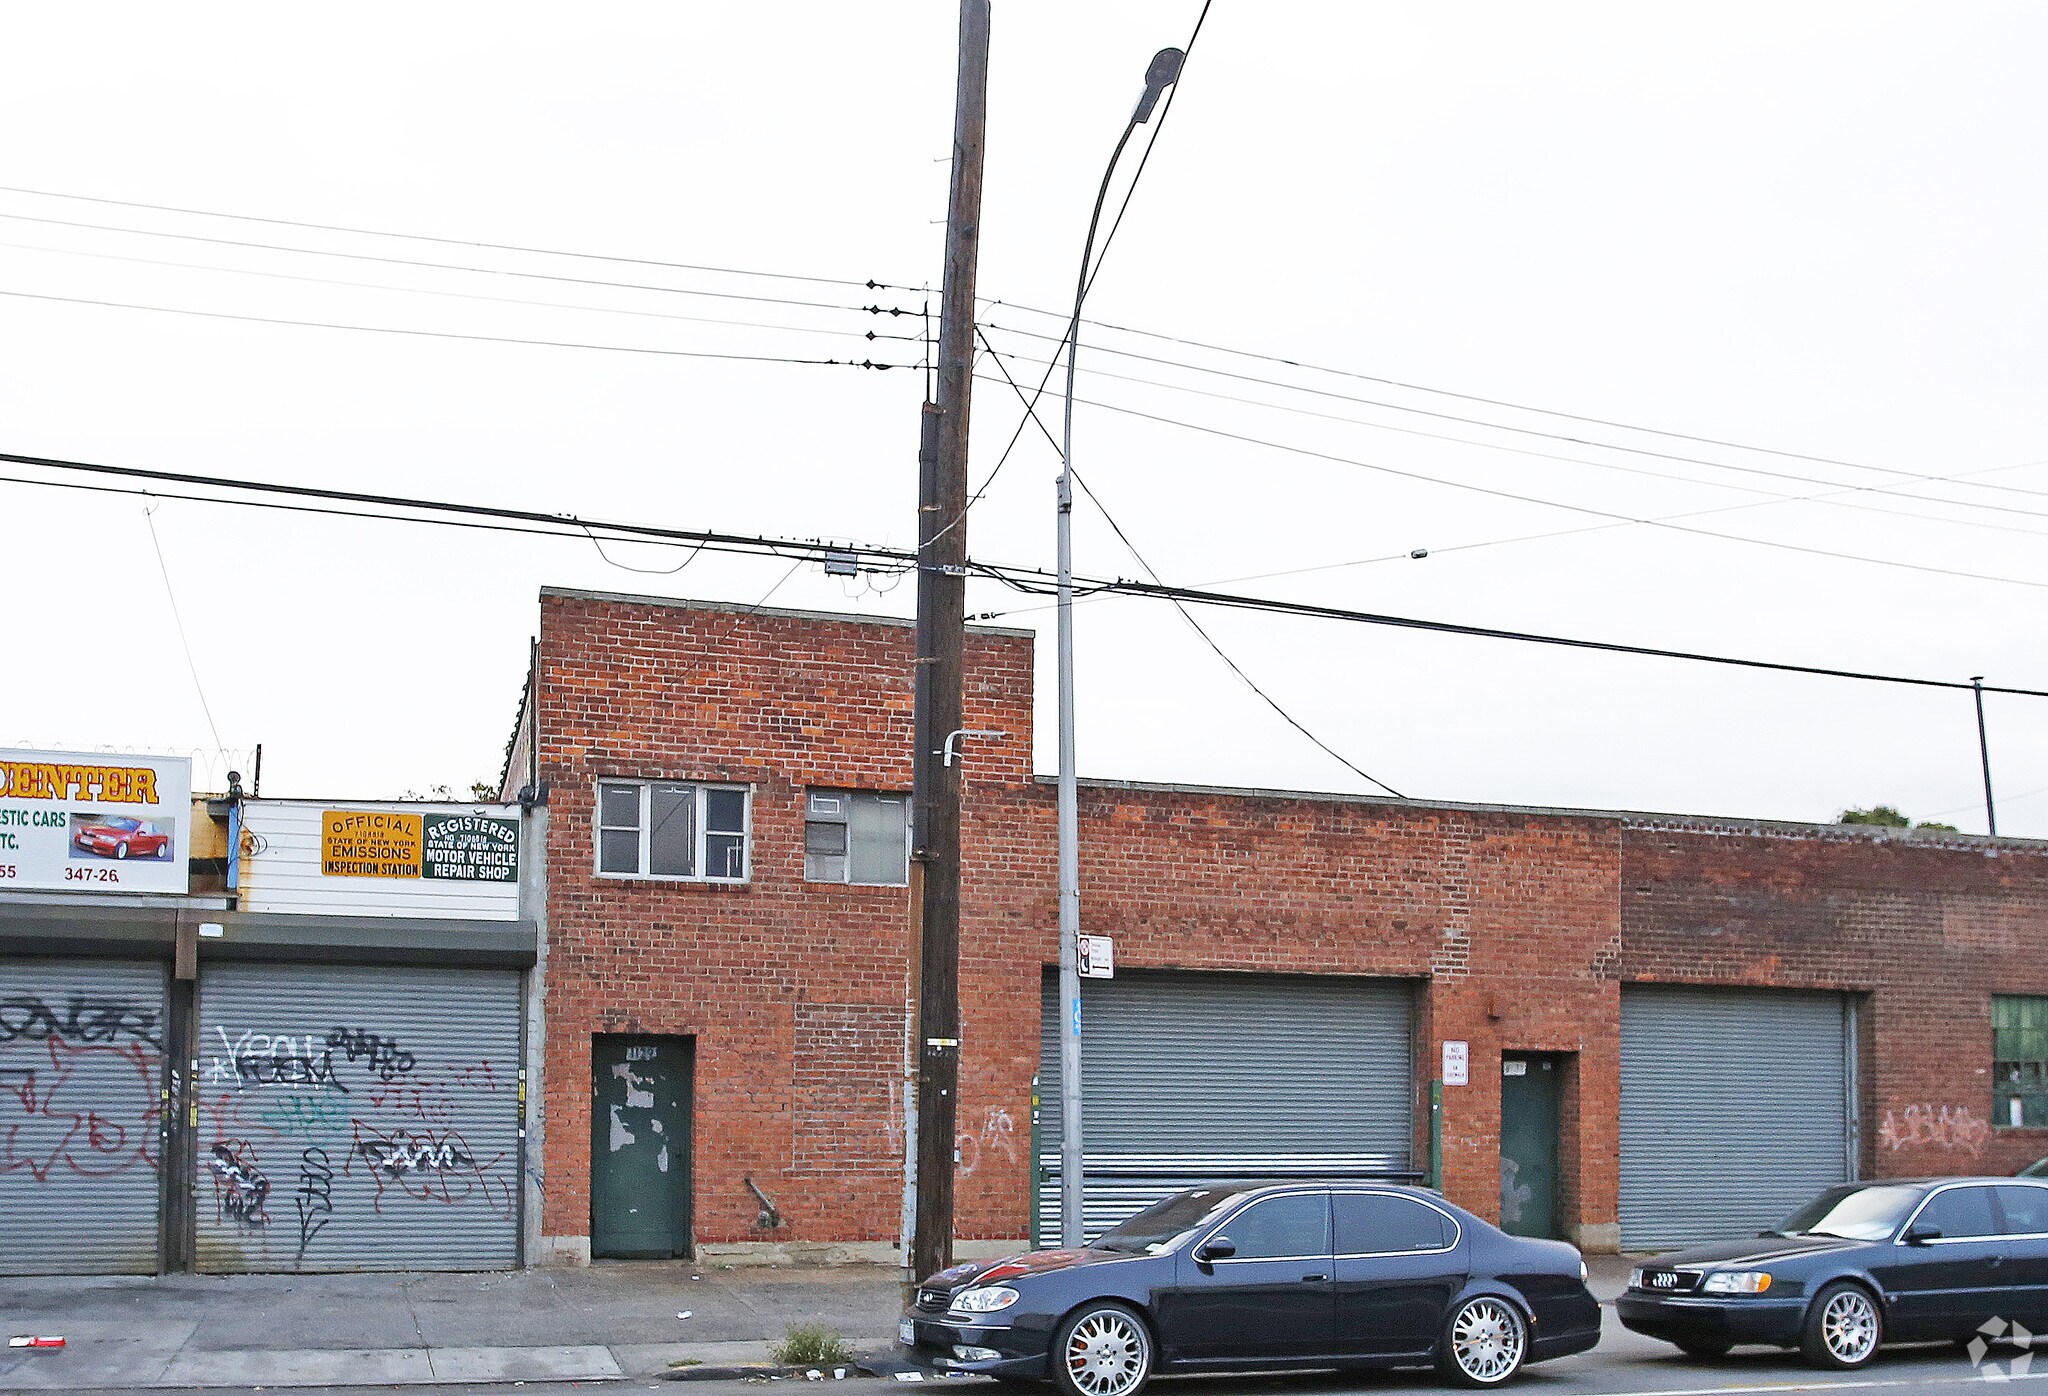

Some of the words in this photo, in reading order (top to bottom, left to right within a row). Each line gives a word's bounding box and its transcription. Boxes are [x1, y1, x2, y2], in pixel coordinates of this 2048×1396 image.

[0, 809, 29, 826] STIC
[32, 810, 66, 828] CARS
[332, 815, 414, 837] OFFICIAL
[427, 817, 515, 843] REGISTERED
[327, 837, 353, 845] STATE
[371, 839, 390, 847] NEW
[393, 840, 416, 848] YORK
[427, 839, 454, 849] STATE
[456, 841, 468, 850] OF
[470, 842, 490, 851] NEW
[492, 843, 515, 853] YORK
[332, 845, 411, 860] EMISSIONS
[426, 848, 466, 864] MOTOR
[468, 850, 517, 867] VEHICLE
[325, 860, 379, 875] INSPECTION
[381, 862, 418, 876] STATION
[434, 863, 475, 879] REPAIR
[479, 865, 510, 880] SHOP
